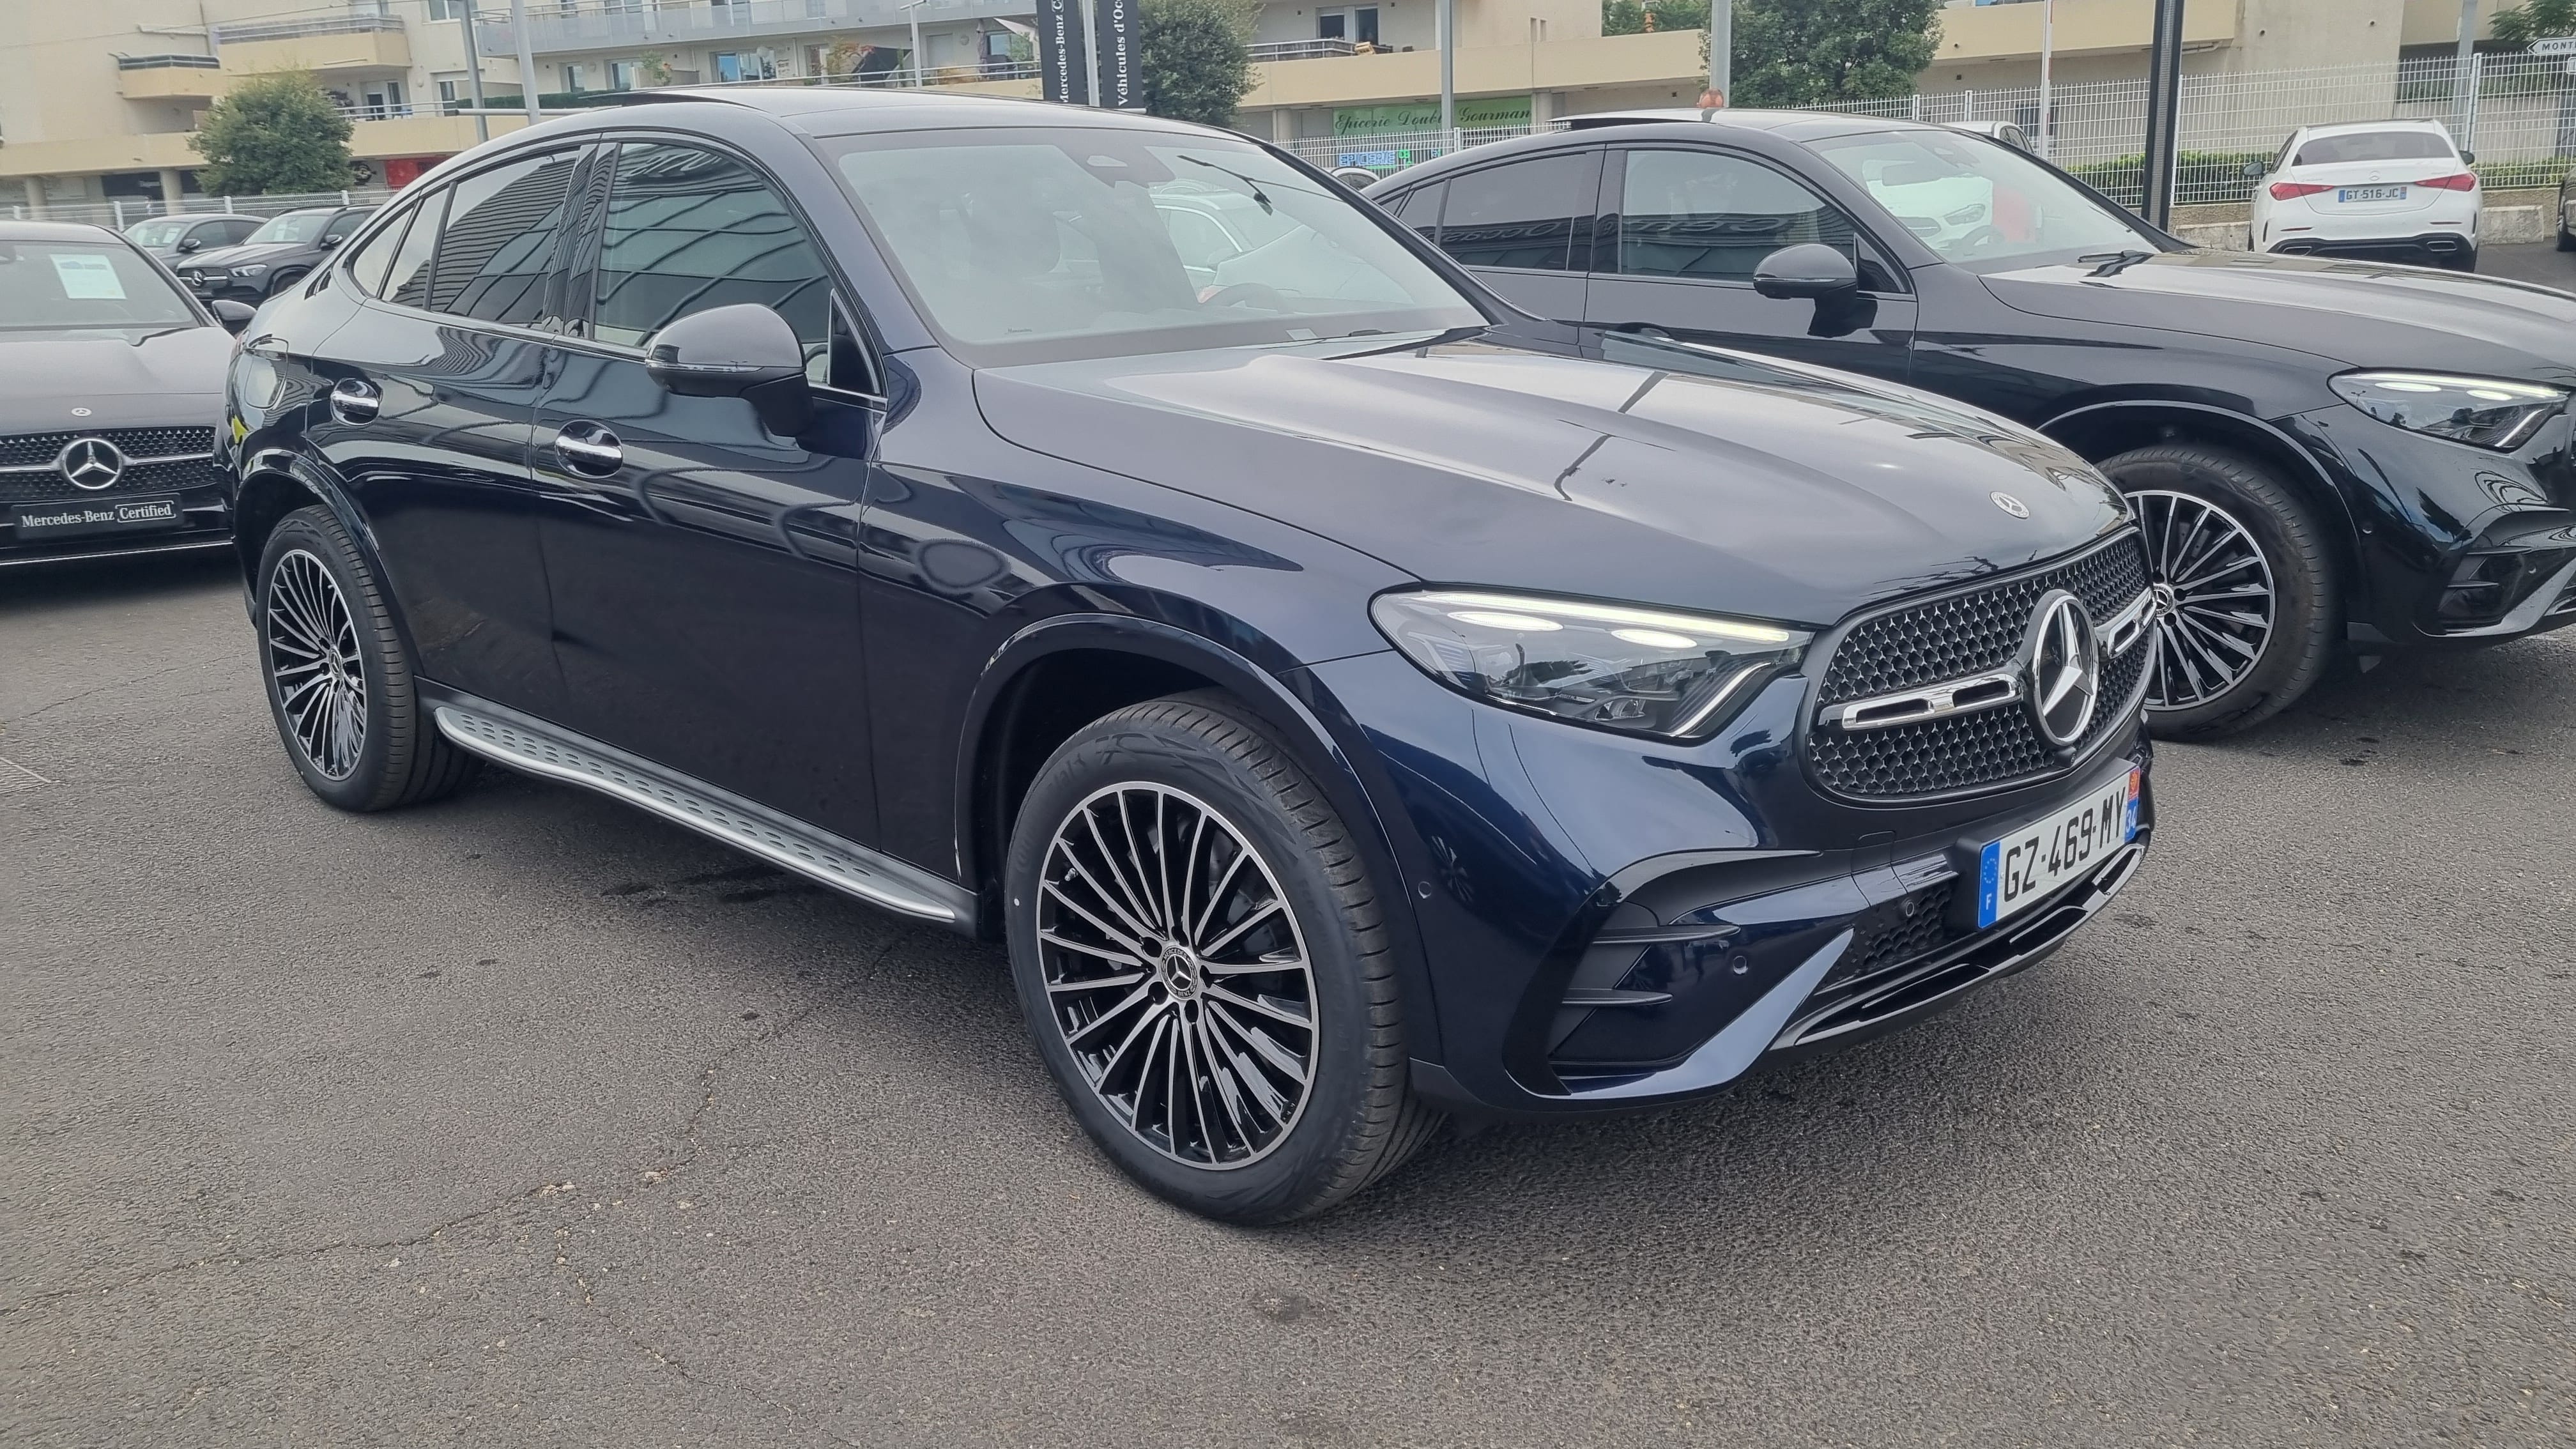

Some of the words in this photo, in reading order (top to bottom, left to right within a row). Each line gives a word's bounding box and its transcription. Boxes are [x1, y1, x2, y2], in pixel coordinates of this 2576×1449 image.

[1113, 0, 1125, 33] d'Oc
[2542, 42, 2576, 50] MONT
[1116, 36, 1129, 106] Véhicules
[1335, 114, 1391, 135] Epicerie
[1398, 108, 1442, 126] Doubl
[1339, 151, 1395, 166] EPICERIE
[2346, 188, 2399, 200] GT-516-JC
[21, 510, 115, 528] Mercedes-Benz
[119, 504, 172, 520] Certified
[2126, 806, 2137, 833] 34
[2004, 786, 2126, 902] GZ-469-MY
[1985, 893, 1992, 910] F
